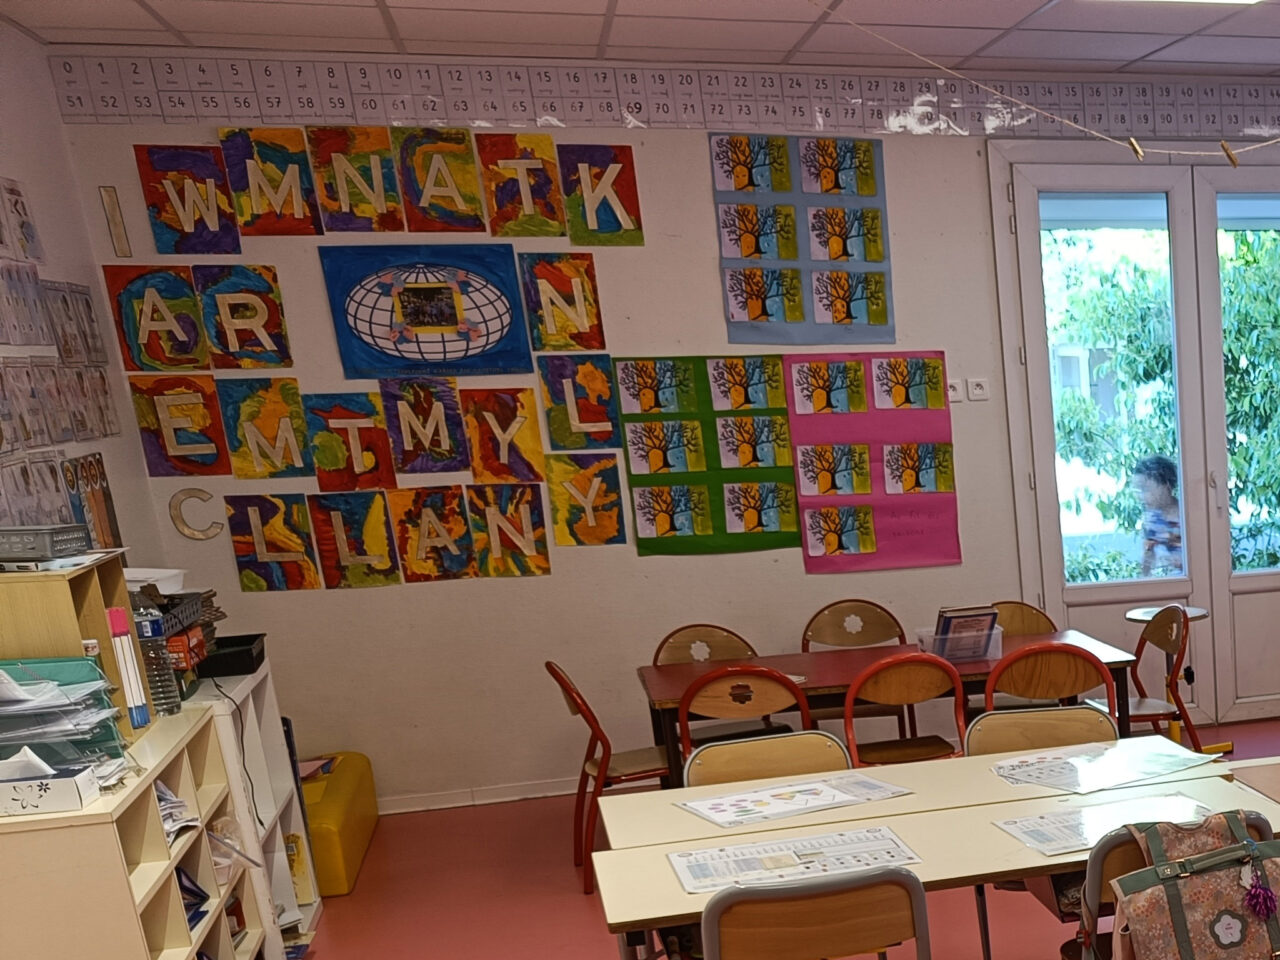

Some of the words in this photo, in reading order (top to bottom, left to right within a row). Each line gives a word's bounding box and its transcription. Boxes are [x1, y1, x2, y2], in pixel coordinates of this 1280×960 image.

[63, 62, 73, 73] 0
[98, 63, 105, 73] 1
[131, 63, 140, 74] 2
[166, 63, 174, 74] 3
[198, 64, 206, 75] 4
[231, 64, 238, 75] 5
[264, 66, 272, 77] 6
[295, 66, 303, 77] 7
[327, 67, 335, 78] 8
[359, 68, 367, 79] 9
[386, 69, 402, 80] 10
[417, 69, 431, 80] 11
[448, 70, 462, 81] 12
[477, 70, 492, 82] 13
[507, 71, 522, 82] 14
[537, 71, 551, 82] 15
[566, 72, 580, 83] 16
[594, 72, 608, 83] 17
[624, 73, 638, 84] 18
[651, 74, 665, 85] 19
[678, 74, 693, 86] 20
[706, 75, 720, 86] 21
[734, 76, 748, 87] 22
[761, 77, 775, 88] 23
[788, 78, 802, 89] 24
[815, 79, 828, 89] 25
[841, 80, 854, 91] 26
[867, 80, 880, 91] 27
[893, 81, 906, 92] 28
[918, 82, 931, 93] 29
[968, 84, 980, 94] 31
[1017, 86, 1030, 96] 33
[1041, 87, 1053, 96] 34
[1065, 87, 1077, 97] 35
[1089, 87, 1101, 97] 36
[1112, 87, 1123, 97] 37
[1136, 87, 1147, 97] 38
[1158, 87, 1170, 97] 39
[1181, 87, 1193, 97] 40
[1203, 87, 1214, 97] 41
[1226, 88, 1237, 98] 42
[1248, 89, 1259, 98] 43
[1269, 89, 1280, 98] 44
[66, 96, 84, 107] 51
[101, 96, 118, 107] 52
[134, 96, 152, 108] 53
[169, 96, 185, 108] 54
[201, 97, 219, 108] 55
[234, 97, 251, 108] 56
[266, 97, 281, 108] 57
[298, 97, 314, 108] 58
[329, 97, 345, 108] 59
[361, 99, 377, 110] 60
[392, 99, 406, 110] 61
[422, 100, 437, 111] 62
[453, 101, 469, 112] 63
[483, 101, 497, 112] 64
[512, 101, 527, 112] 65
[542, 101, 557, 112] 66
[571, 101, 584, 112] 67
[599, 102, 613, 112] 68
[626, 102, 642, 113] 69
[655, 103, 670, 114] 70
[682, 103, 696, 114] 71
[710, 104, 724, 114] 72
[737, 104, 751, 115] 73
[764, 105, 778, 115] 74
